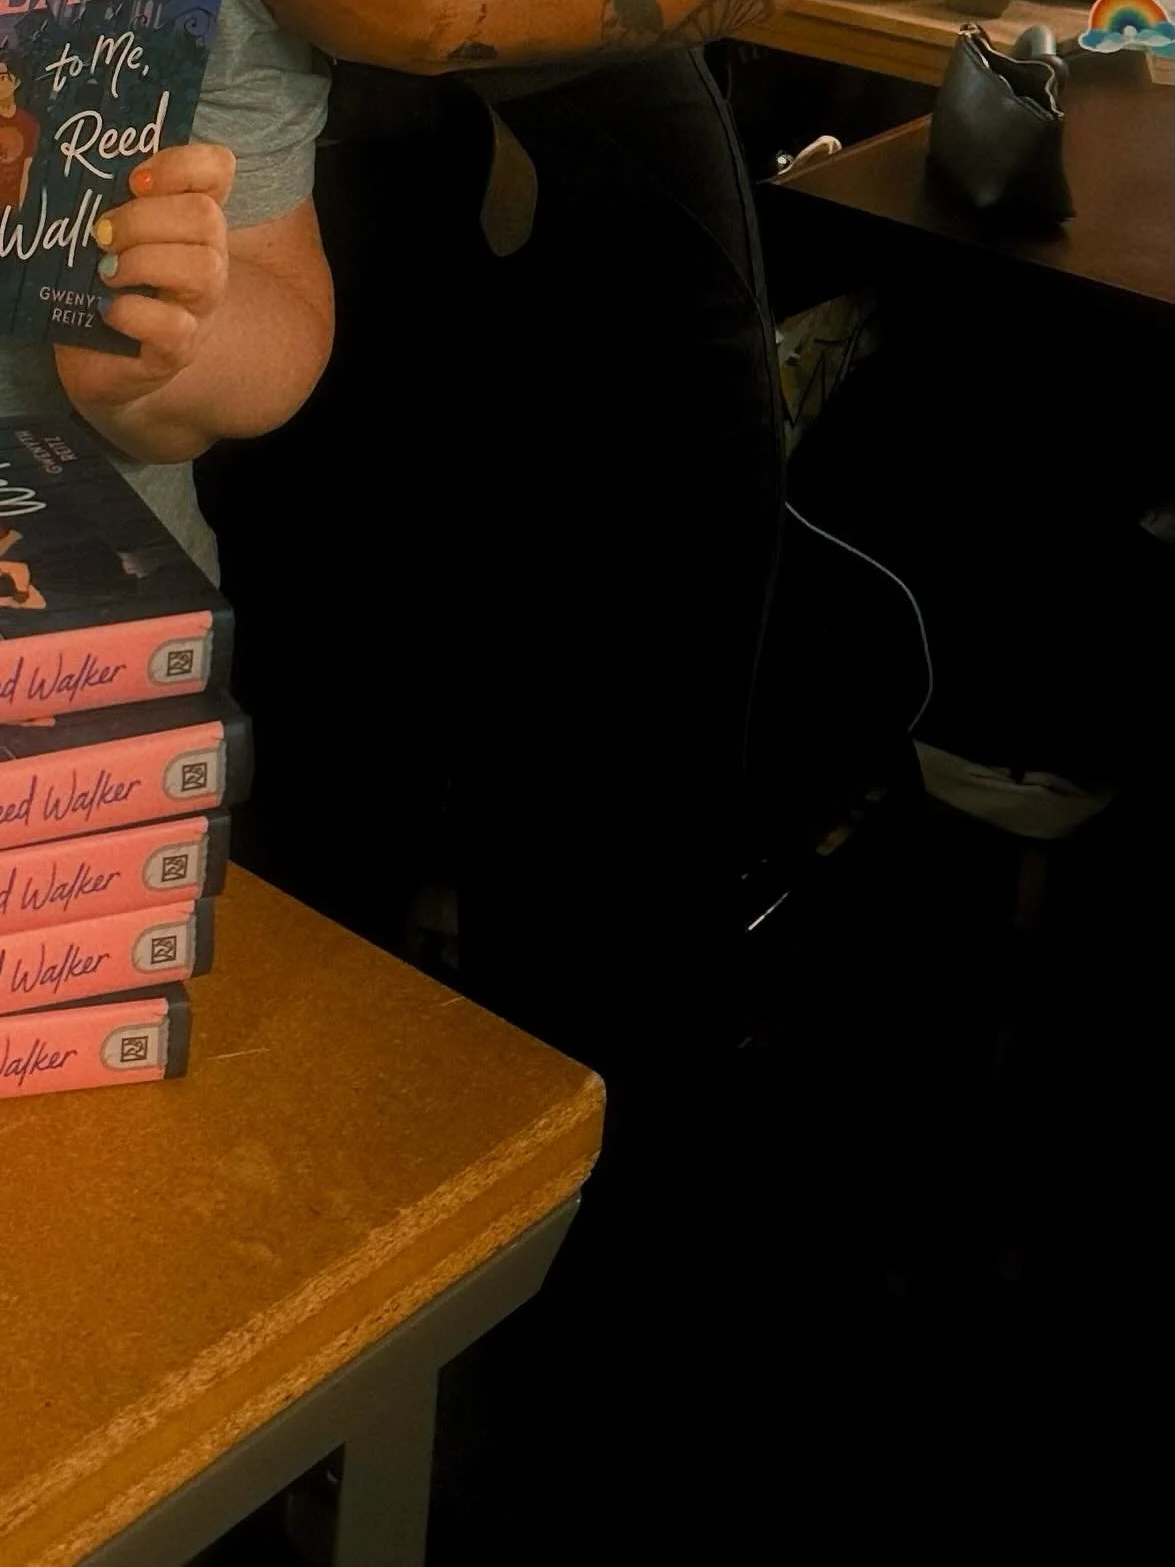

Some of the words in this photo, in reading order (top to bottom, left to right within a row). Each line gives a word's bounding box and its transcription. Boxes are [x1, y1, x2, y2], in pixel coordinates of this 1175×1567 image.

[45, 42, 82, 93] to
[90, 31, 149, 98] Me,
[54, 90, 170, 180] Reed
[40, 286, 102, 306] GWENY
[52, 308, 94, 329] REITZ
[44, 436, 78, 462] REITZ
[28, 653, 126, 701] Walker
[44, 769, 141, 822] Walker
[22, 862, 121, 912] Walker
[11, 944, 110, 994] Walker
